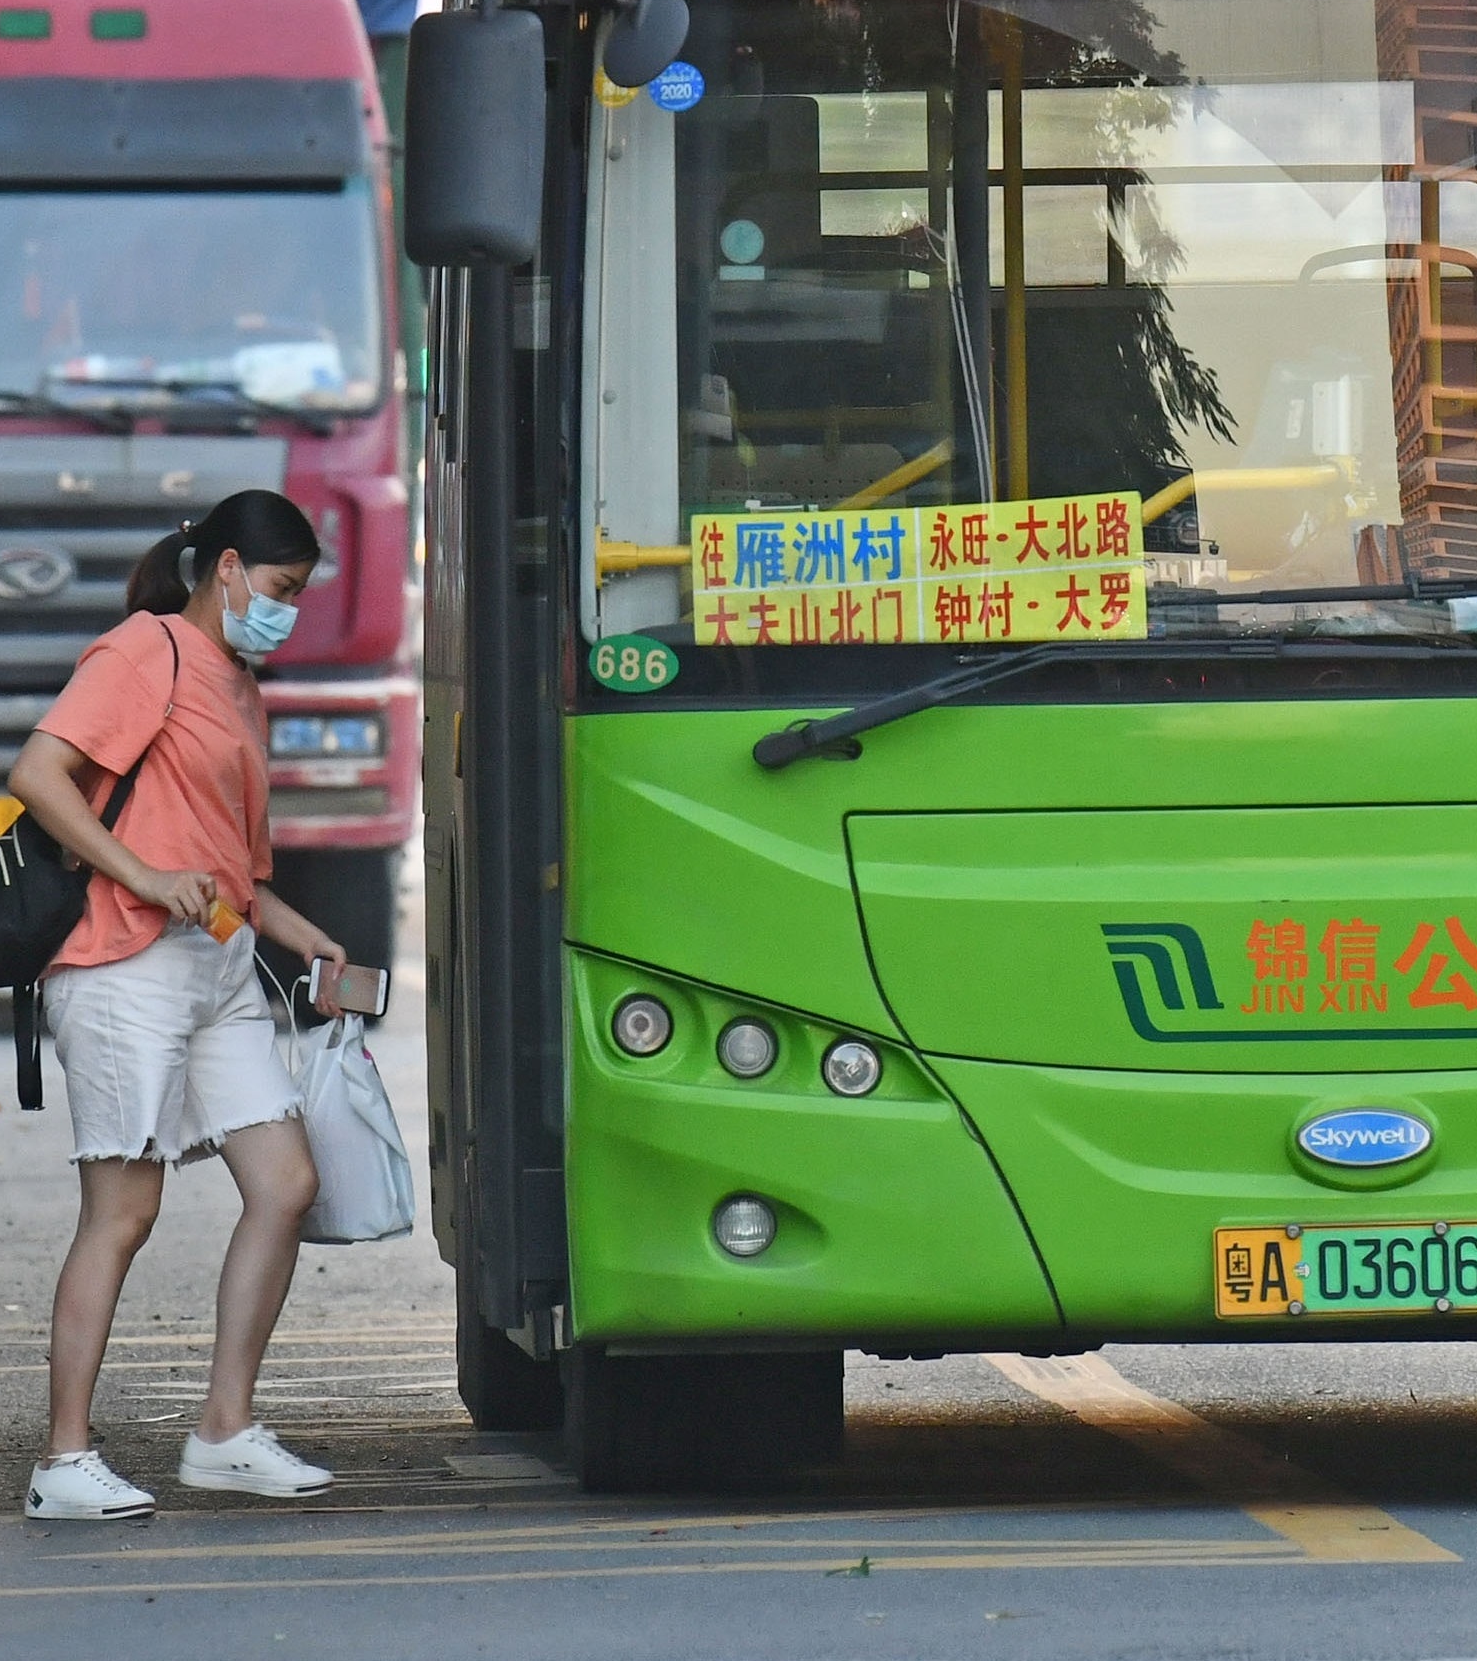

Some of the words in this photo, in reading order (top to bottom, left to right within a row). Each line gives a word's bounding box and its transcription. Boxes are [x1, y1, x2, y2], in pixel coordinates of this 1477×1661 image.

[660, 83, 693, 100] 2020
[704, 587, 903, 645] 大夫山北门
[595, 645, 668, 685] 686
[1239, 984, 1304, 1014] JIN
[1317, 984, 1389, 1013] XIN
[1310, 1124, 1421, 1149] Skywell
